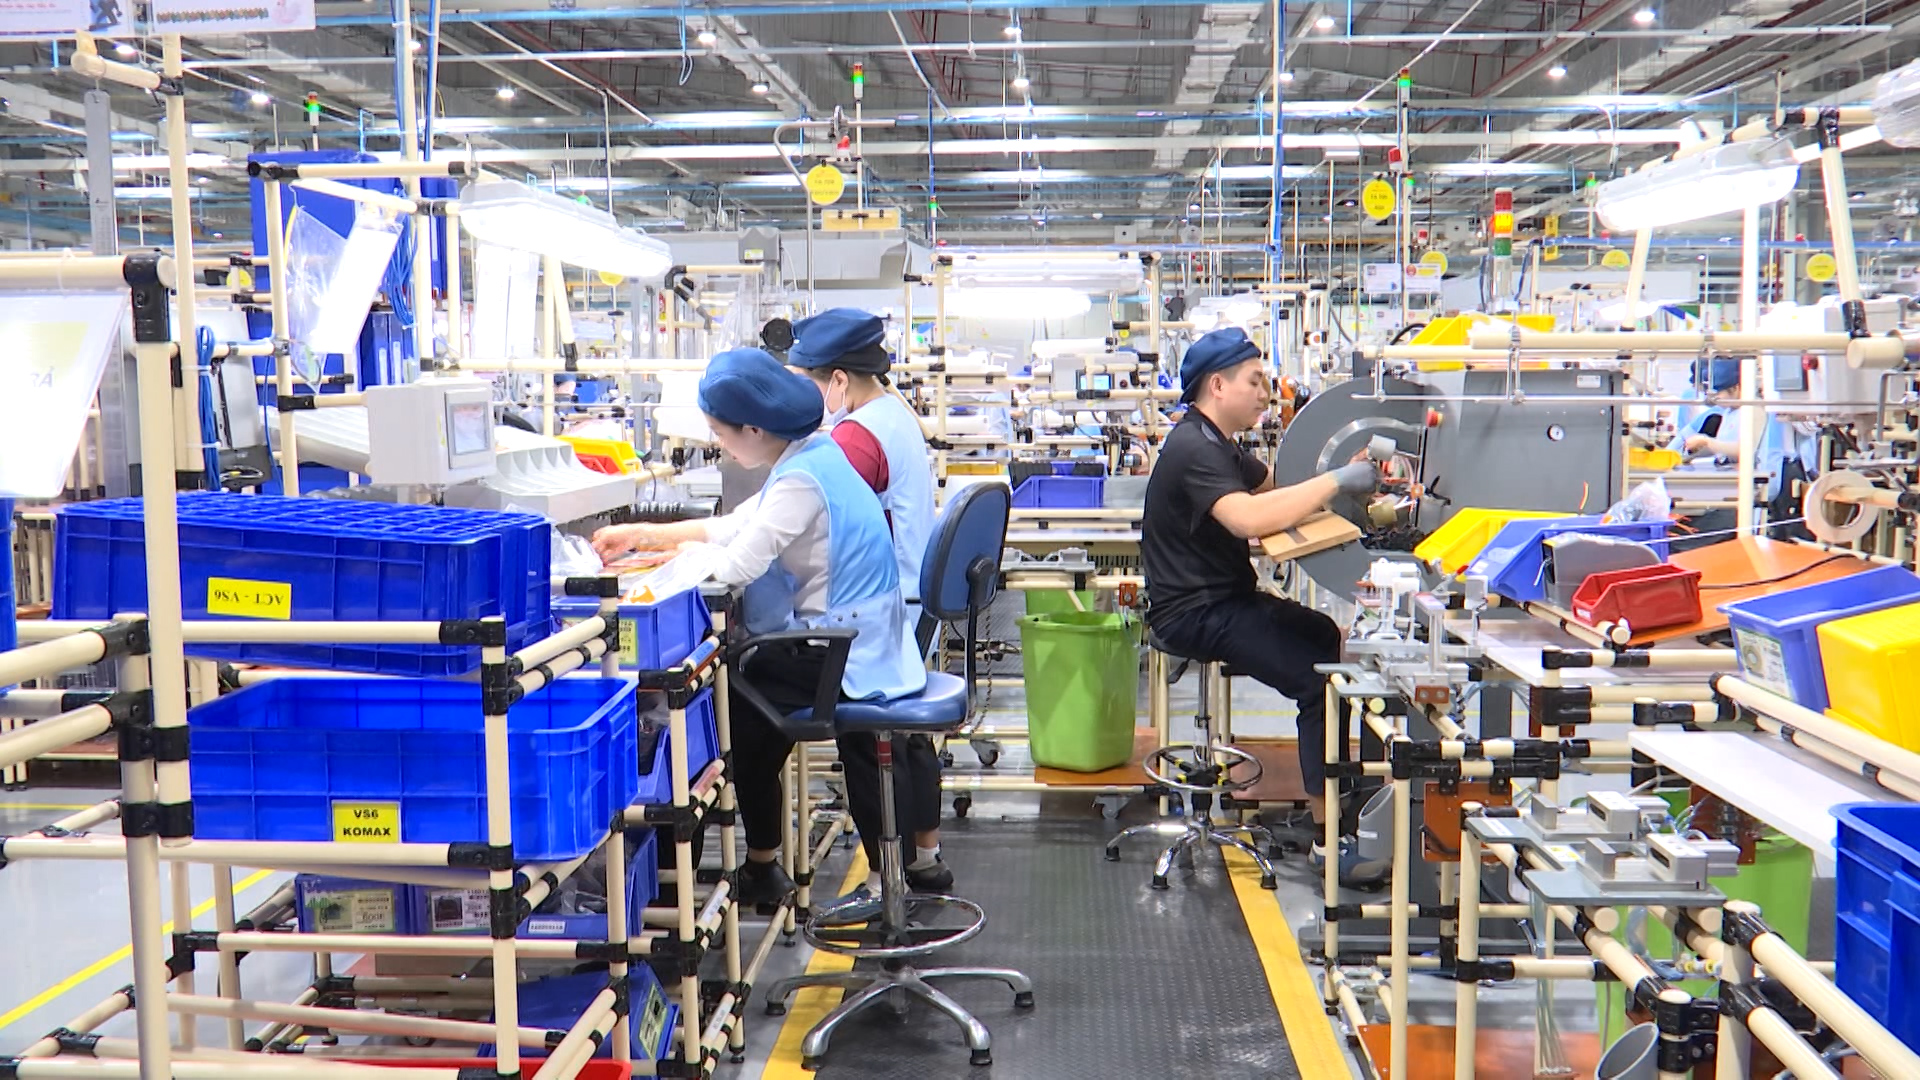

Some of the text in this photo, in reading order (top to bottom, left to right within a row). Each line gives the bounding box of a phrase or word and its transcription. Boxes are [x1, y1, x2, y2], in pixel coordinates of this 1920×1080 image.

[214, 589, 241, 604] VS6
[254, 593, 285, 606] ACT
[353, 809, 380, 820] VS6
[343, 827, 392, 837] KOMAX
